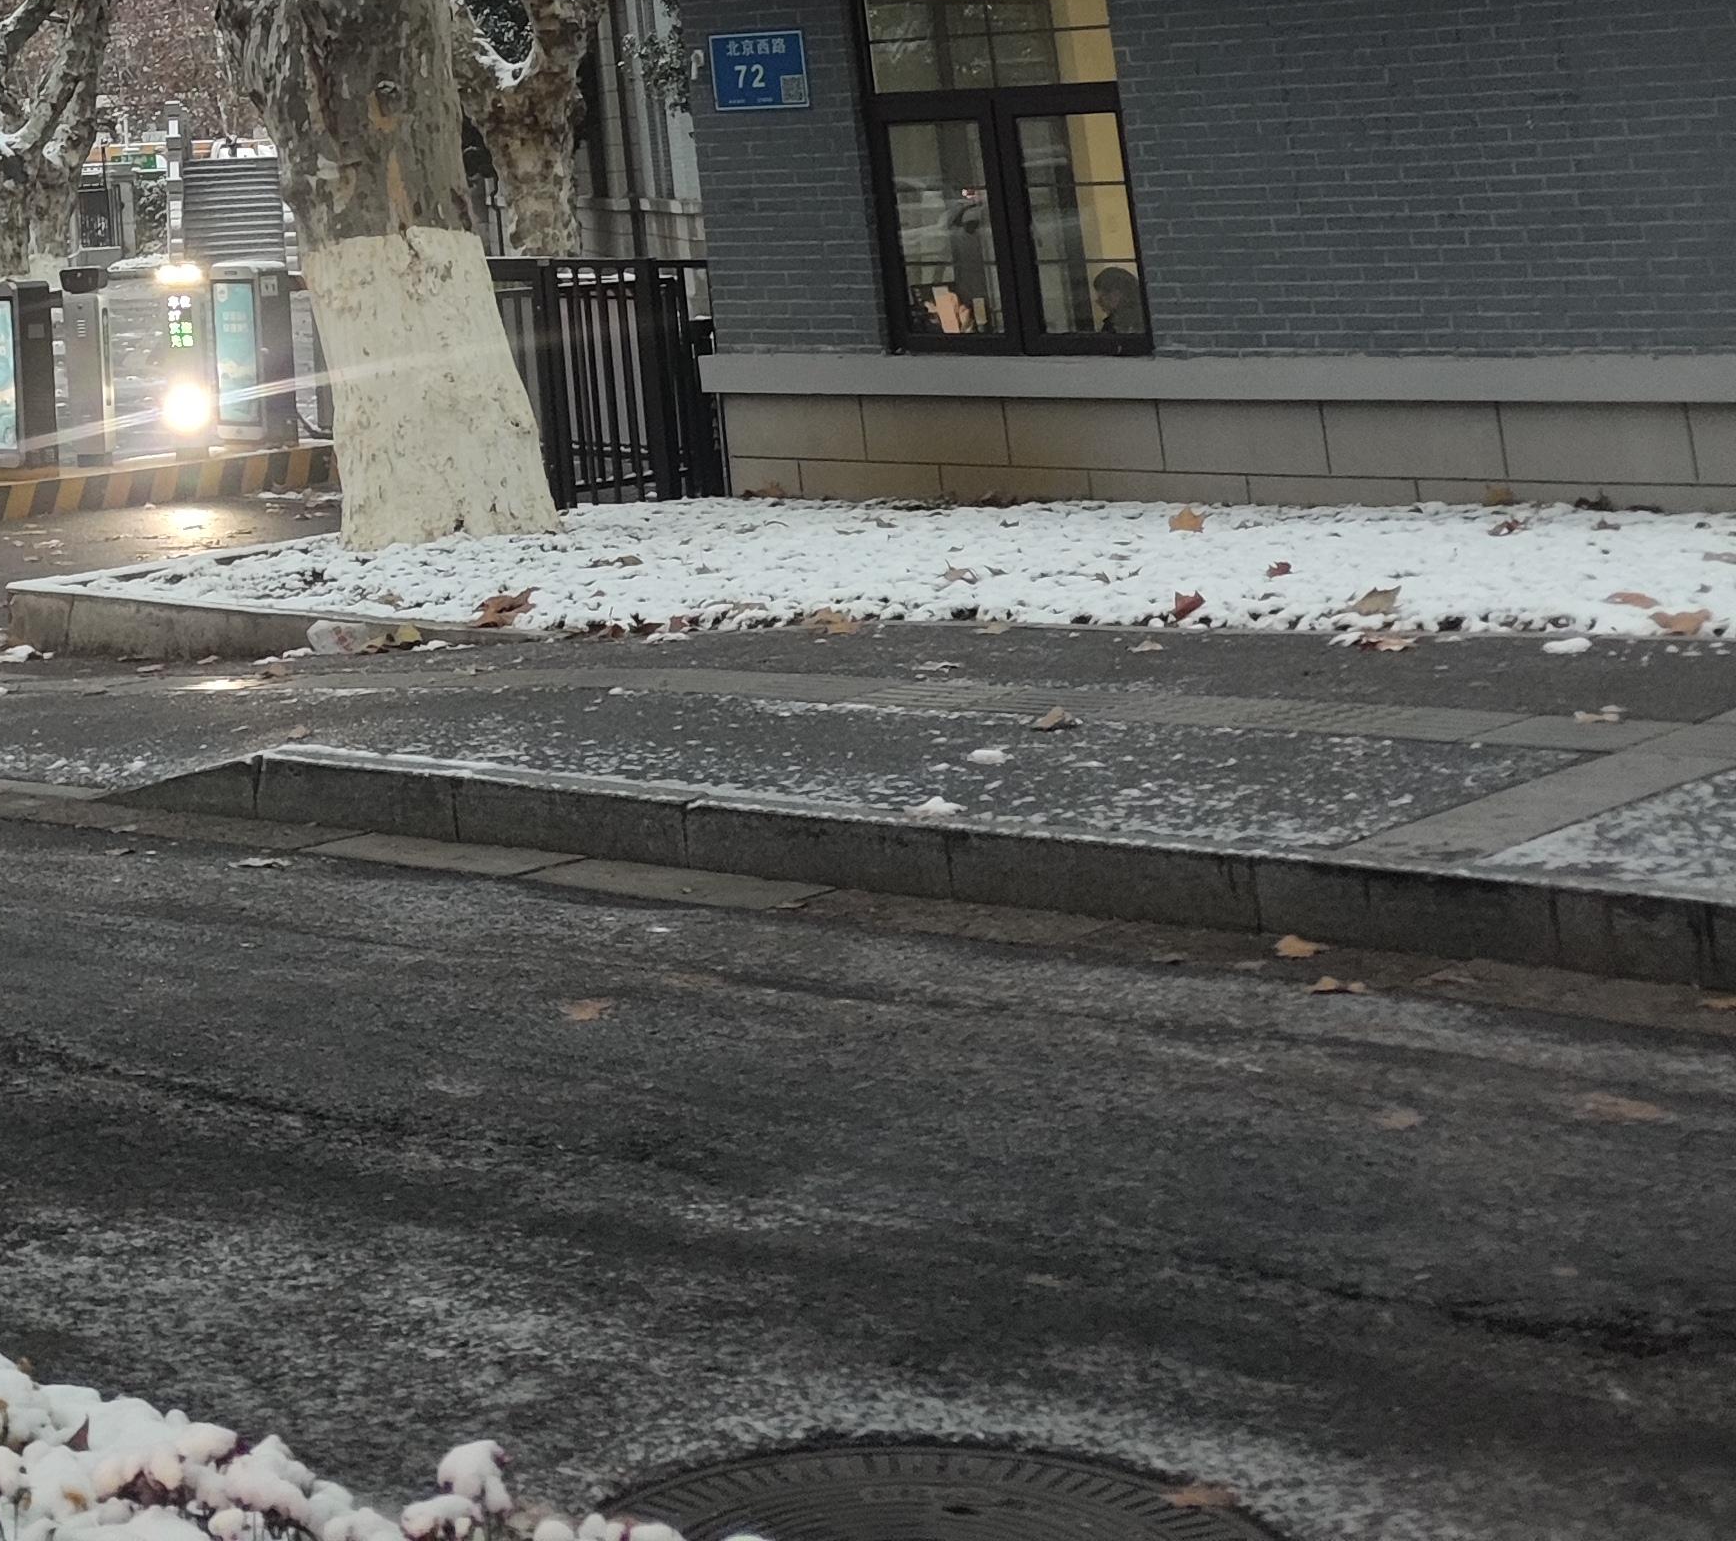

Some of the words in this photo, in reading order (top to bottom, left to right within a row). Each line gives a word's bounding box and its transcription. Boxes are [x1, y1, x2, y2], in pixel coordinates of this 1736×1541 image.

[726, 38, 786, 57] 北京西路
[734, 63, 766, 89] 72
